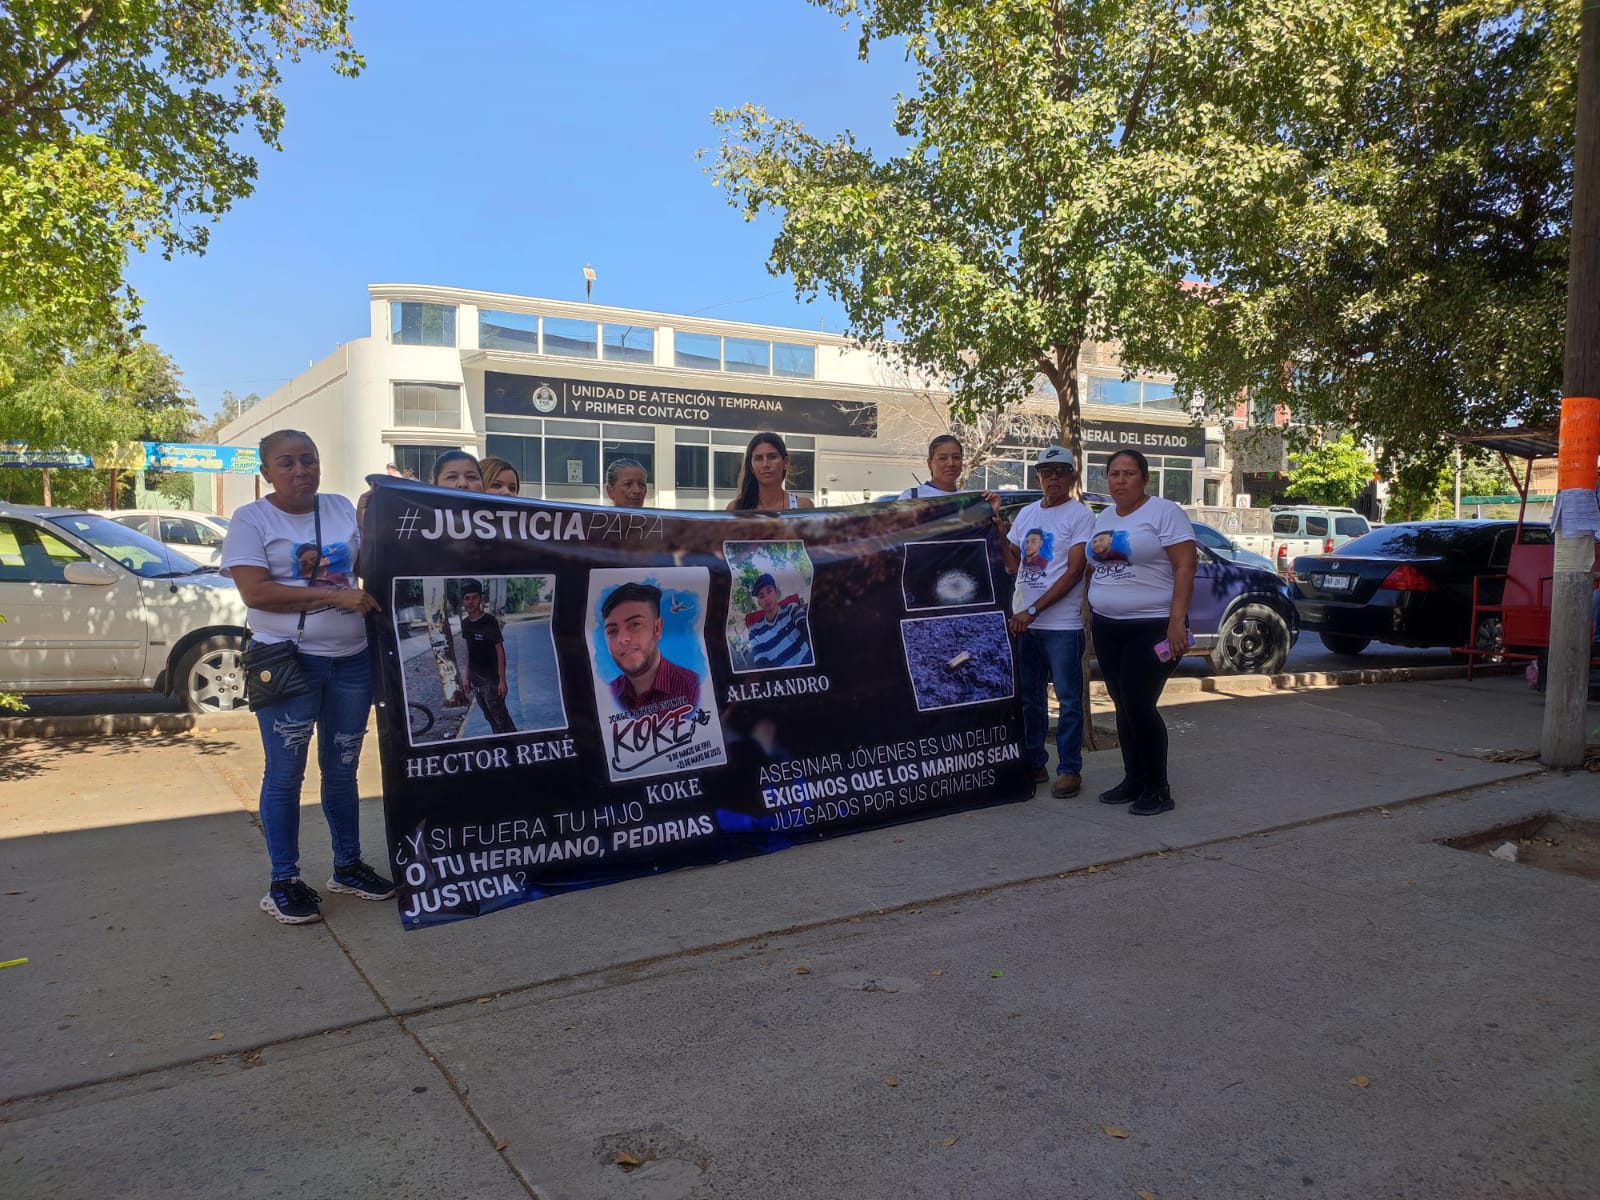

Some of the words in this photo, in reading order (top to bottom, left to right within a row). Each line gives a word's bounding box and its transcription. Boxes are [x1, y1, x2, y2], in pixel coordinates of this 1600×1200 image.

[571, 384, 625, 400] UNIDAD
[629, 390, 647, 401] DE
[650, 391, 715, 407] ATENCIÓN
[718, 396, 783, 412] TEMPRANA
[571, 400, 581, 411] Y
[585, 401, 635, 415] PRIMER
[638, 405, 710, 420] CONTACTO
[1079, 429, 1118, 443] NERAL
[1120, 432, 1142, 445] DEL
[1144, 433, 1188, 447] ESTADO
[726, 675, 830, 702] ALEJANDRO
[406, 746, 512, 778] HECTOR
[516, 734, 578, 765] RENÉ
[612, 704, 694, 763] KOKE
[759, 753, 843, 785] ASESINAR
[847, 739, 917, 769] JÓVENES
[920, 737, 940, 756] ES
[941, 733, 962, 751] UN
[966, 724, 1008, 748] DELITO
[646, 778, 703, 804] KOKE
[761, 776, 848, 809] EXIGIMOS
[852, 769, 885, 792] QUE
[888, 763, 919, 784] LOS
[921, 750, 986, 779] MARINOS
[986, 742, 1020, 764] SEAN
[770, 798, 860, 832] JUZGADOS
[864, 790, 895, 814] POR
[899, 784, 927, 805] SUS
[930, 768, 996, 799] CRÍMENES
[395, 829, 423, 866] ¿Y
[432, 828, 453, 851] SI
[462, 817, 546, 847] FUERA
[553, 808, 586, 834] TU
[593, 801, 644, 829] HIJO
[405, 863, 427, 887] O
[432, 855, 465, 879] TU
[469, 835, 606, 874] HERMANO,
[612, 814, 715, 851] PEDIRIAS
[404, 871, 527, 917] JUSTICIA?
